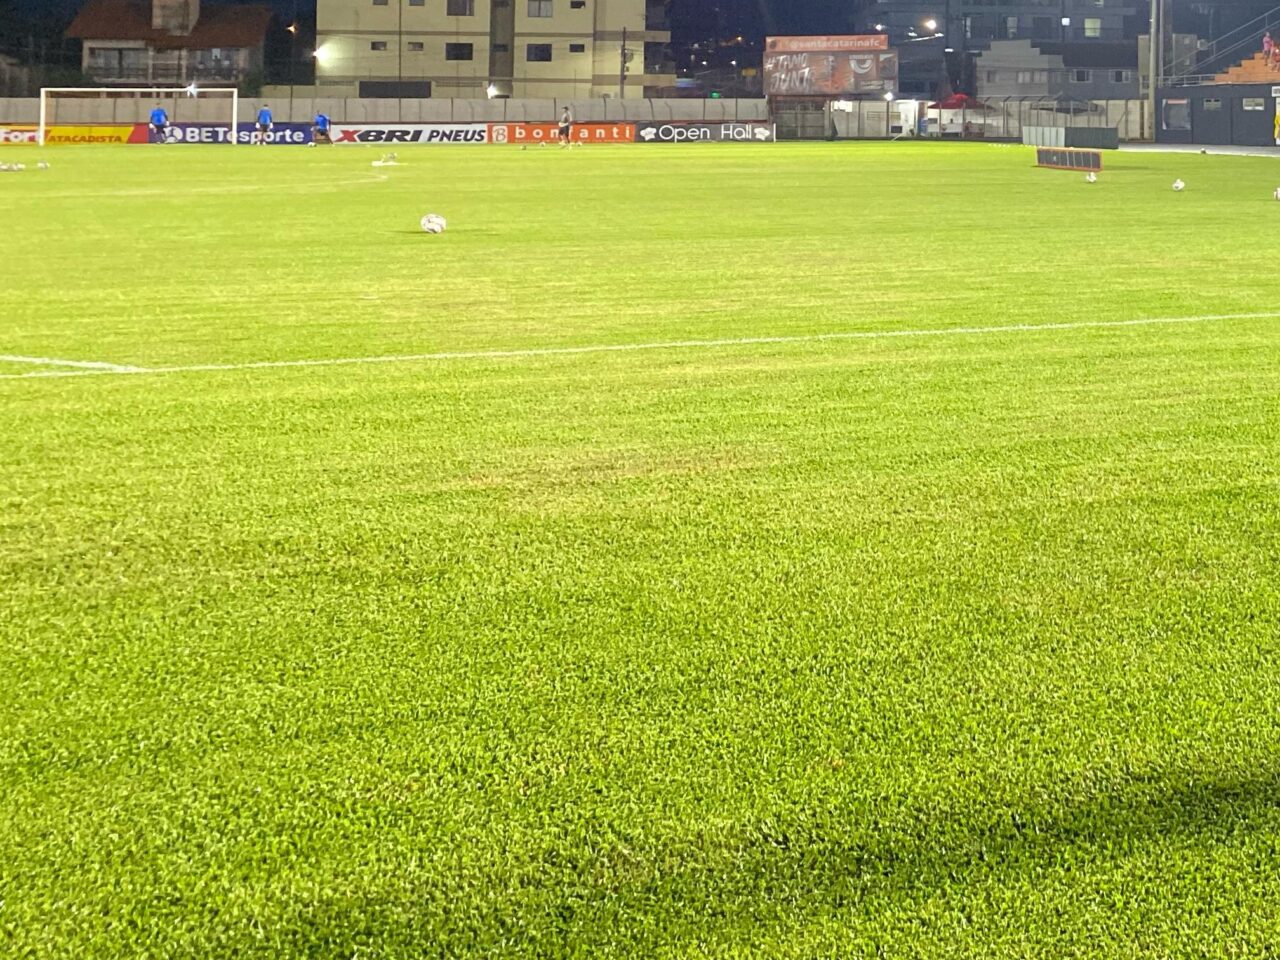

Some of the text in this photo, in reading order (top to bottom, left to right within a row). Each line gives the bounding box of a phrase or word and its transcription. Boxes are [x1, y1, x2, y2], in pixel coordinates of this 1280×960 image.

[334, 129, 487, 142] XBRI PNEUS
[515, 126, 631, 138] bonanti
[658, 124, 752, 143] Open Hall
[48, 135, 123, 143] ATACADISTA
